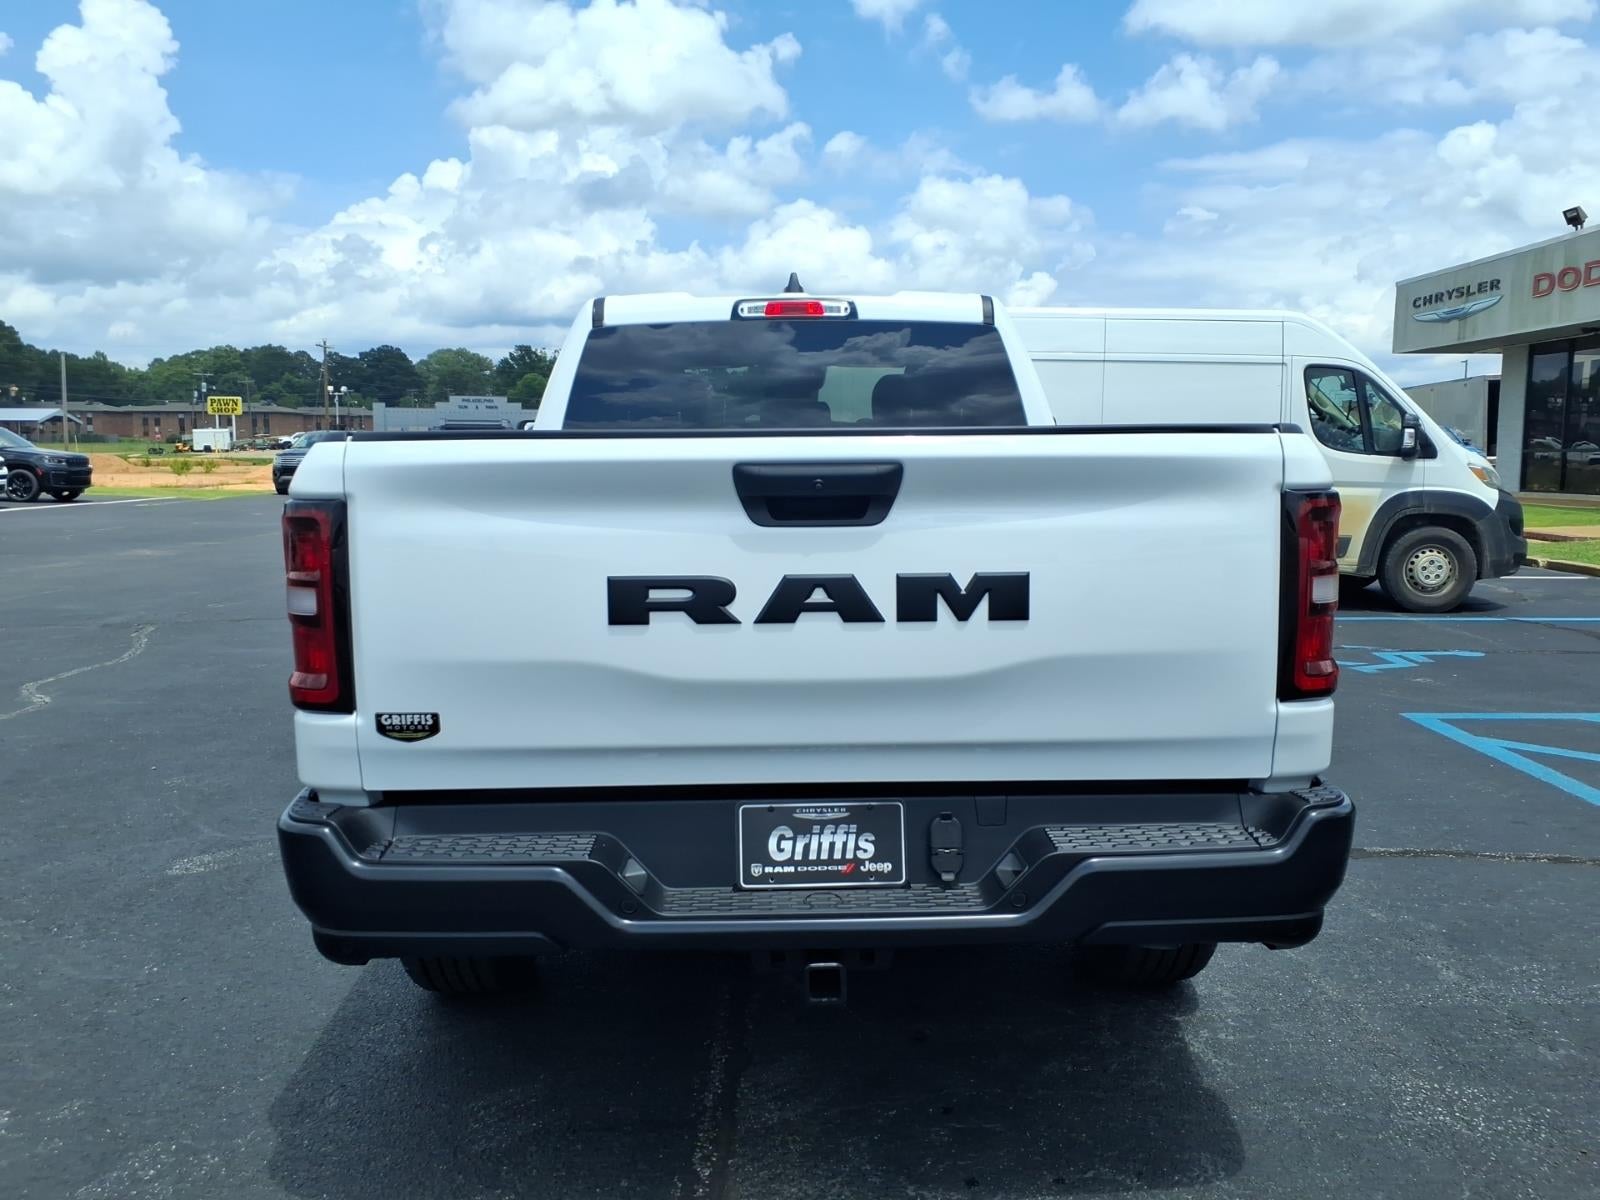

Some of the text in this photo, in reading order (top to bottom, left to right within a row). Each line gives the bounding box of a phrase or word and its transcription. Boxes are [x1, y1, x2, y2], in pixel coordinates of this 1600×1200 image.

[1412, 279, 1502, 309] CHRYSLER
[209, 398, 239, 407] PAWN
[607, 572, 1030, 625] RAM
[380, 714, 433, 726] GRIFFIS
[768, 824, 876, 862] Griffis
[860, 860, 892, 873] Jeep
